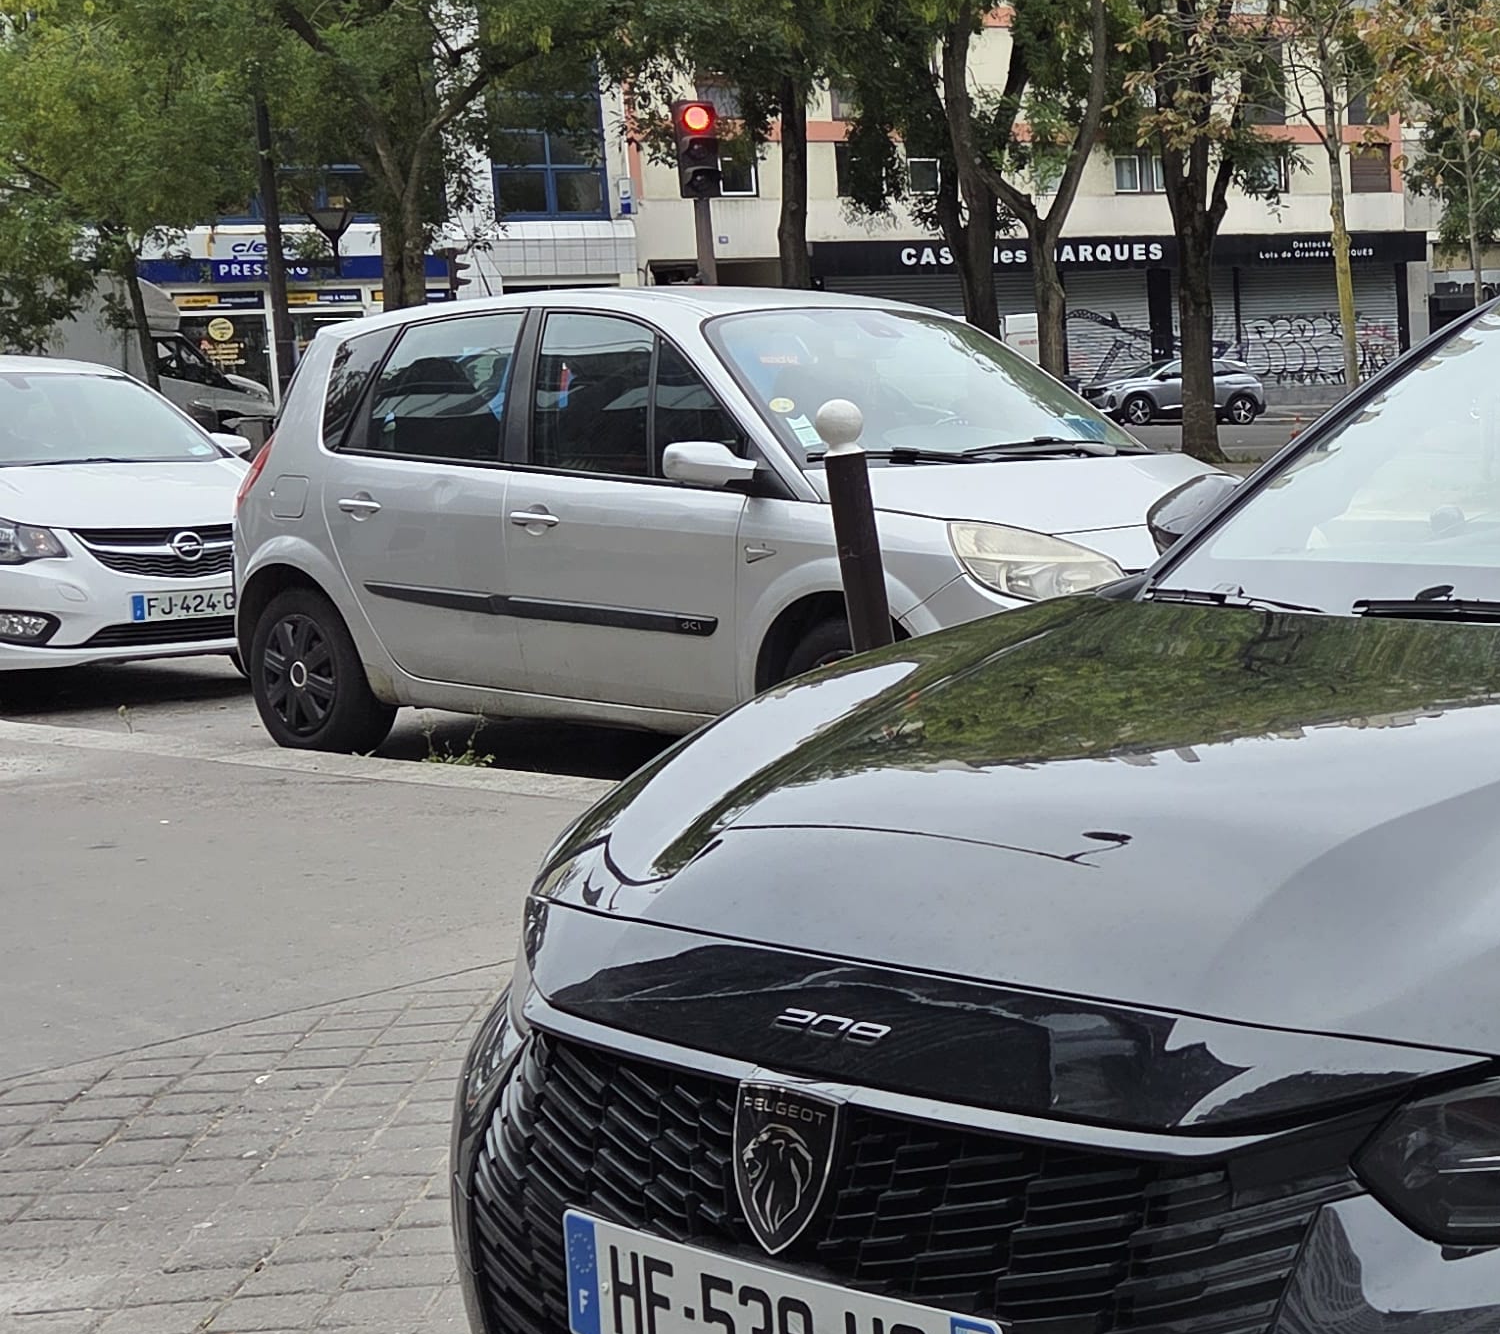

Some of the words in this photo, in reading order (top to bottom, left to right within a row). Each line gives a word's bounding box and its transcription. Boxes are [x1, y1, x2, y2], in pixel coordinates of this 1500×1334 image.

[901, 247, 954, 265] CAS
[771, 1008, 892, 1046] 208
[743, 1096, 828, 1126] PEUGEOT
[578, 1288, 589, 1314] F
